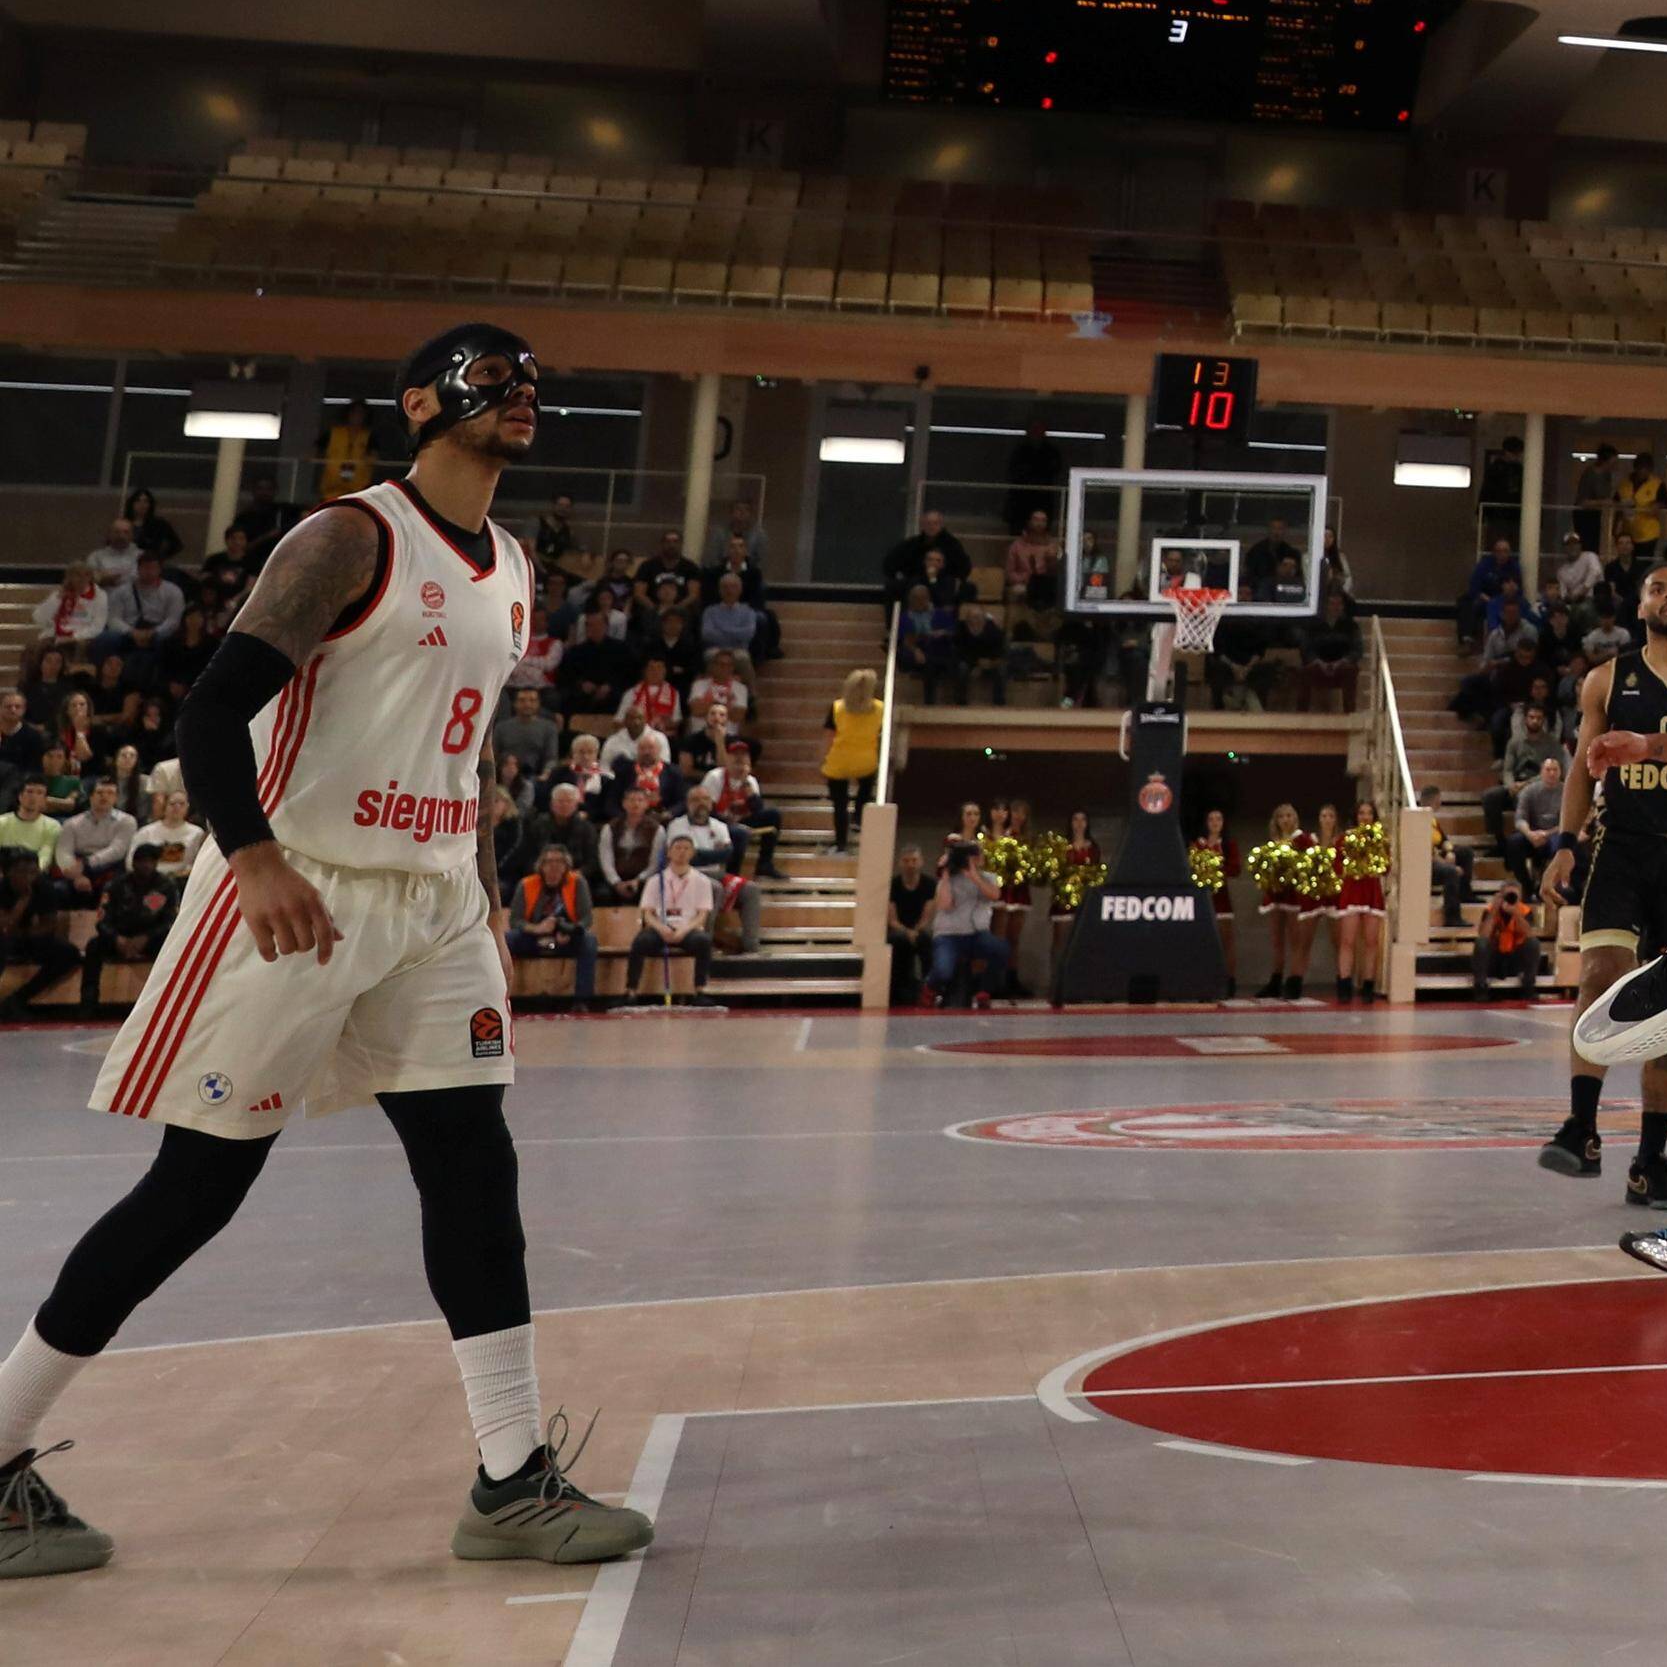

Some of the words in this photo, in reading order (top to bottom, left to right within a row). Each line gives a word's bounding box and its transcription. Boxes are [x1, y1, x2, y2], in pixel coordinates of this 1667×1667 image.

[1168, 19, 1189, 43] 3
[1188, 391, 1235, 429] 10
[441, 687, 483, 755] 8
[1101, 896, 1195, 921] FEDCOM
